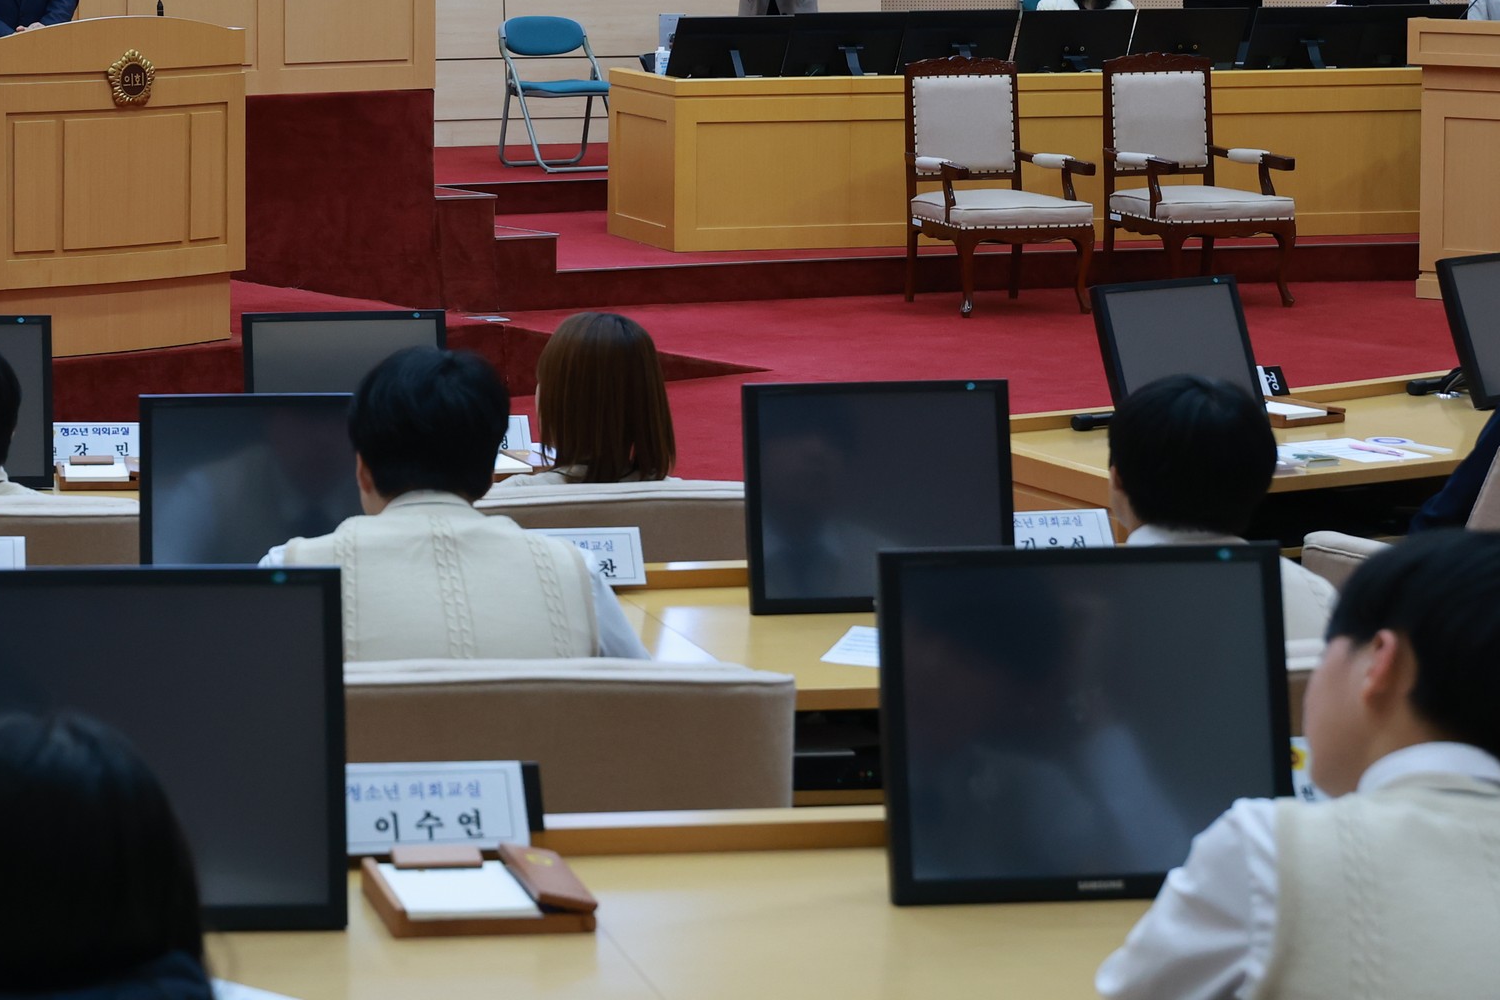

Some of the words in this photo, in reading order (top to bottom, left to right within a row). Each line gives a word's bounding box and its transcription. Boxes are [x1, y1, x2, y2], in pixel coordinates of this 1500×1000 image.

[123, 72, 145, 87] 의회
[60, 427, 89, 437] 청소년
[1038, 515, 1083, 528] 의회교실
[347, 780, 400, 802] 청소년
[408, 780, 482, 800] 의회교실
[374, 806, 485, 842] 이수연
